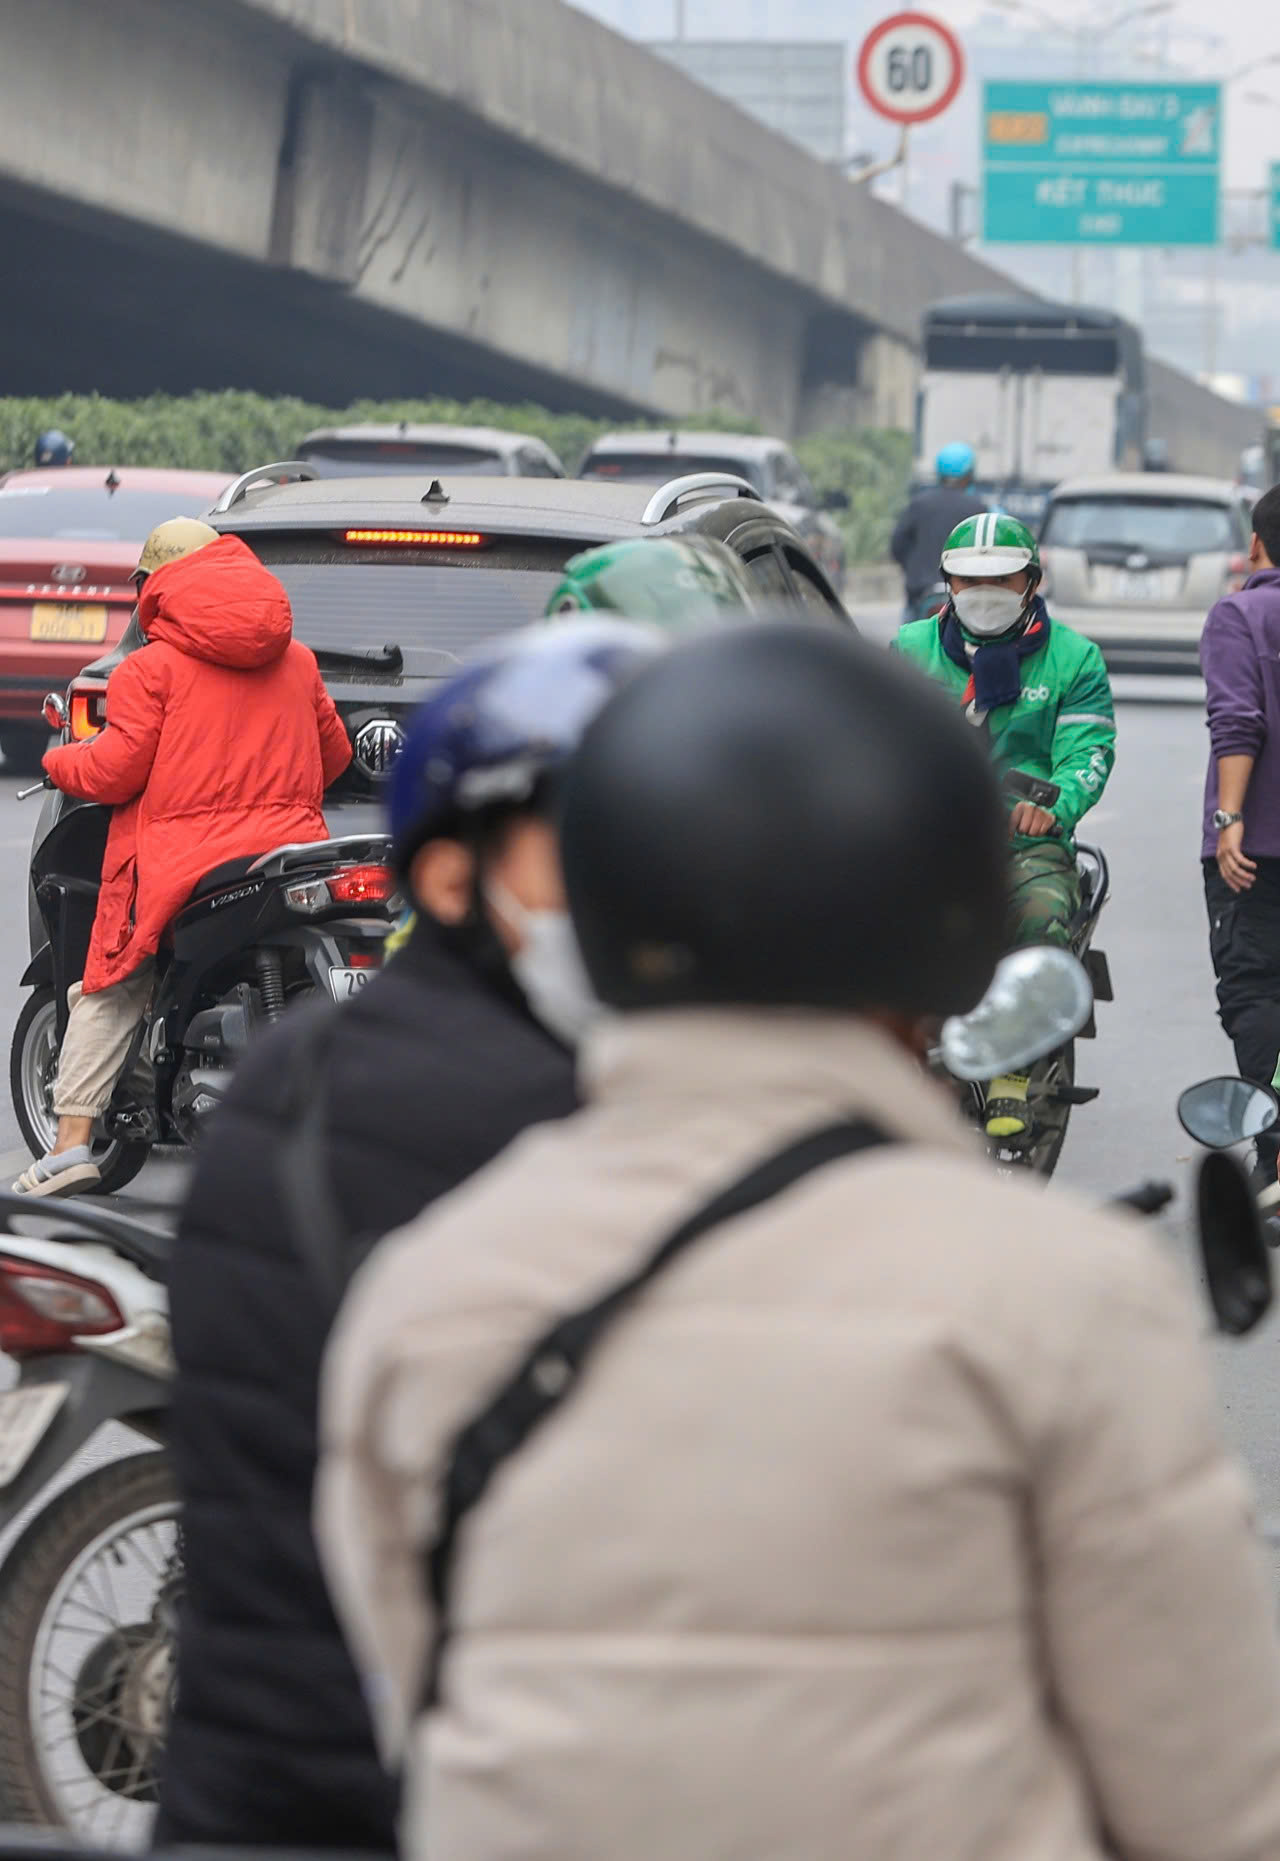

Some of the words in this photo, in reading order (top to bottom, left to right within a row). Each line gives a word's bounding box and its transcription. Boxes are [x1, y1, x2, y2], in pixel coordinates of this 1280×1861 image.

[887, 45, 934, 93] 60
[1020, 683, 1050, 701] rab
[210, 881, 265, 909] VISION
